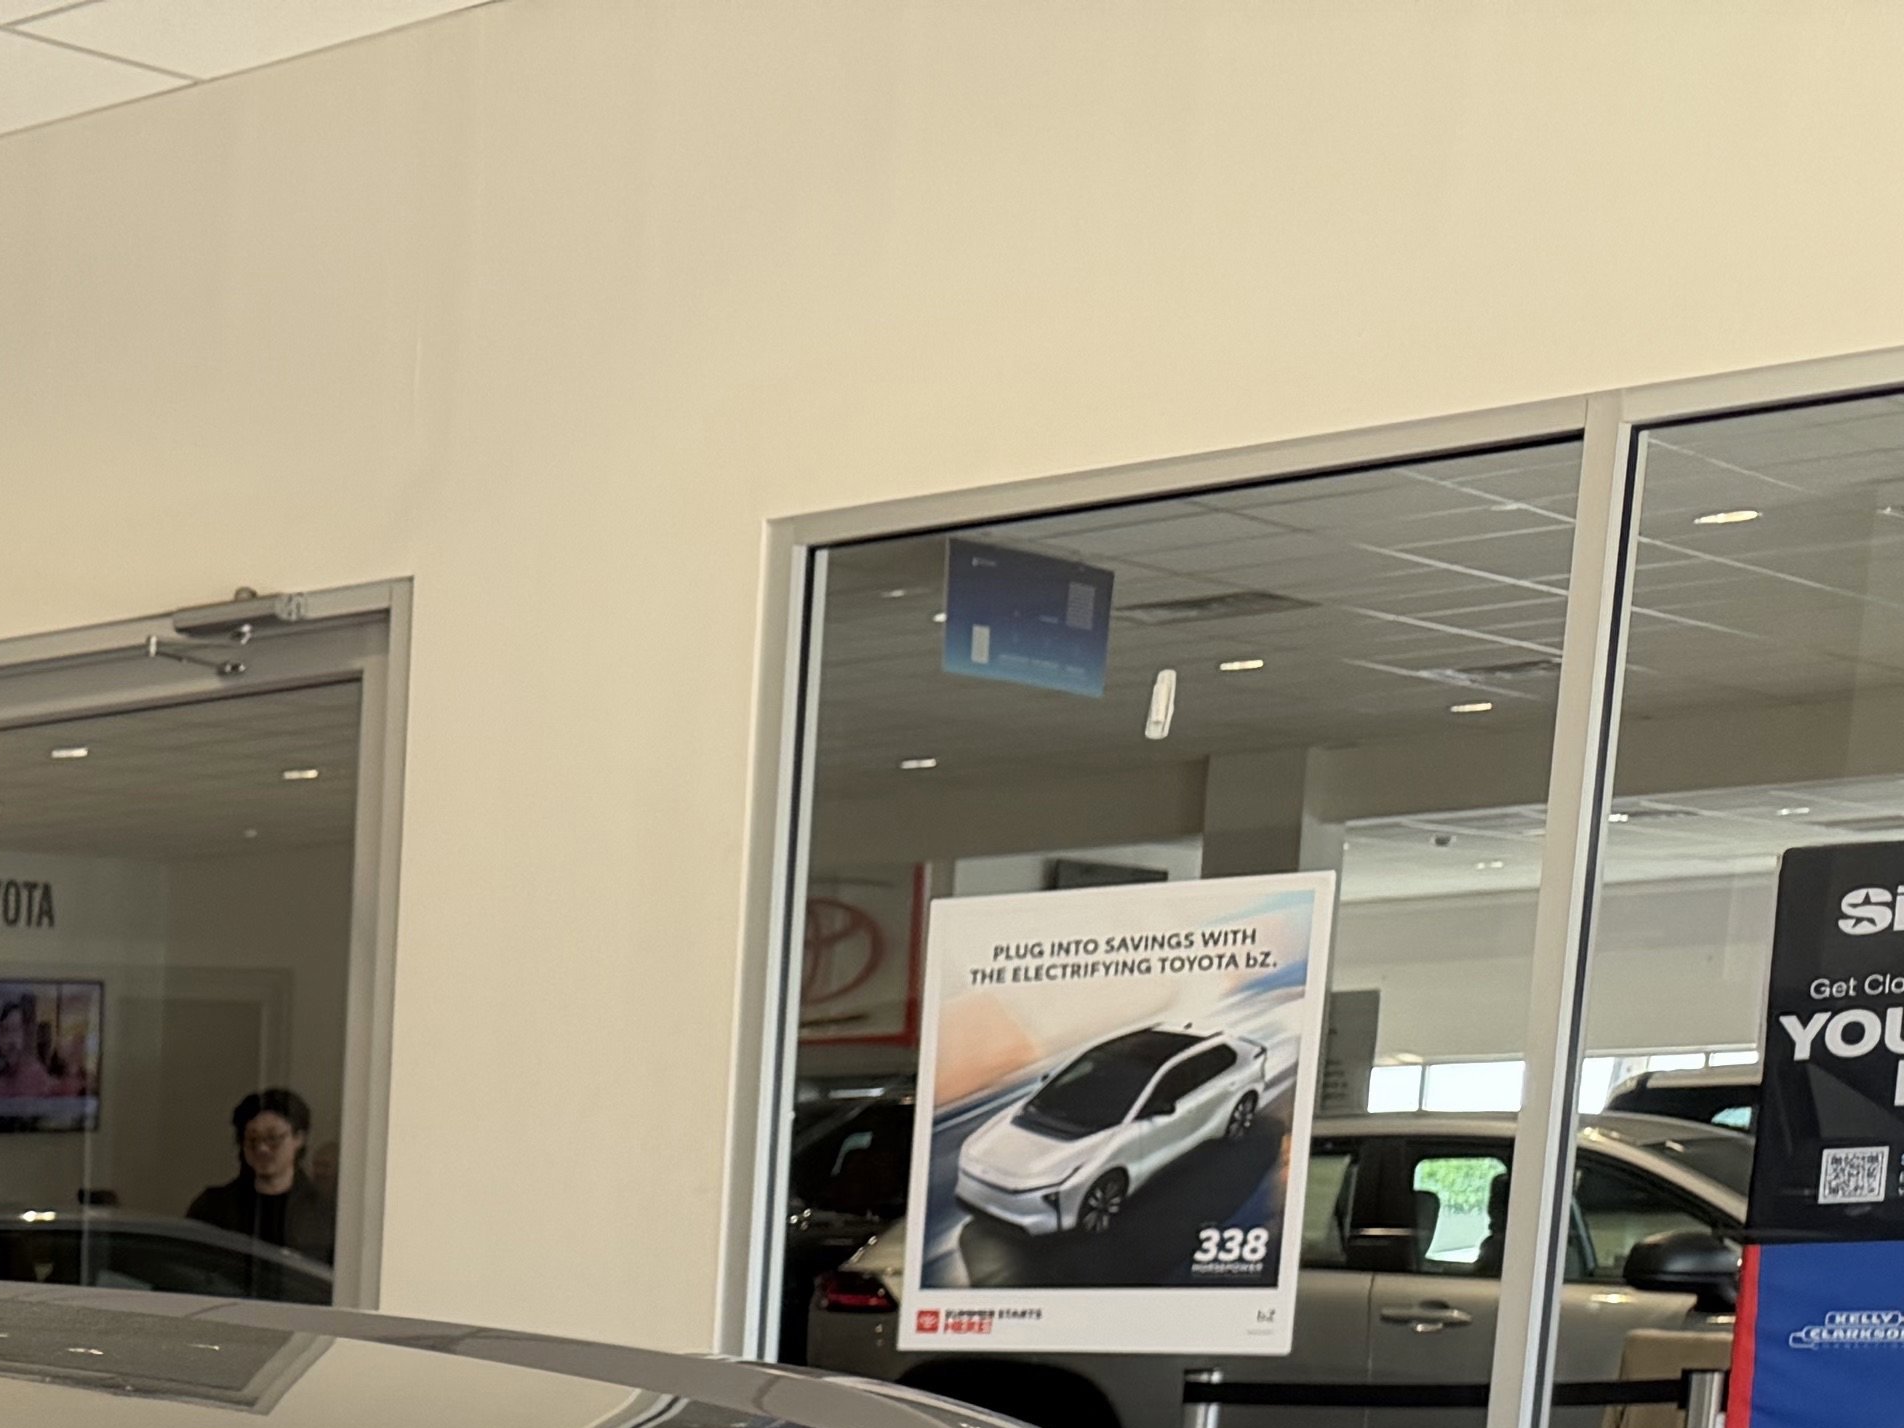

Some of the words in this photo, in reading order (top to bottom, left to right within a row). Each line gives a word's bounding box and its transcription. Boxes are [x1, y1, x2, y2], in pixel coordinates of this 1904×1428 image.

[992, 944, 1045, 961] PLUG
[1050, 939, 1099, 957] INTO
[1104, 931, 1195, 955] SAVINGS
[1201, 928, 1257, 948] WITH
[969, 967, 1006, 986] THE
[1011, 958, 1152, 984] ELECTRIFYING
[1158, 953, 1239, 974] TOYOTA
[1245, 951, 1278, 969] bZ.
[1809, 976, 1858, 1000] Get
[1193, 1226, 1269, 1262] 338
[1809, 1328, 1904, 1340] CLARKSO
